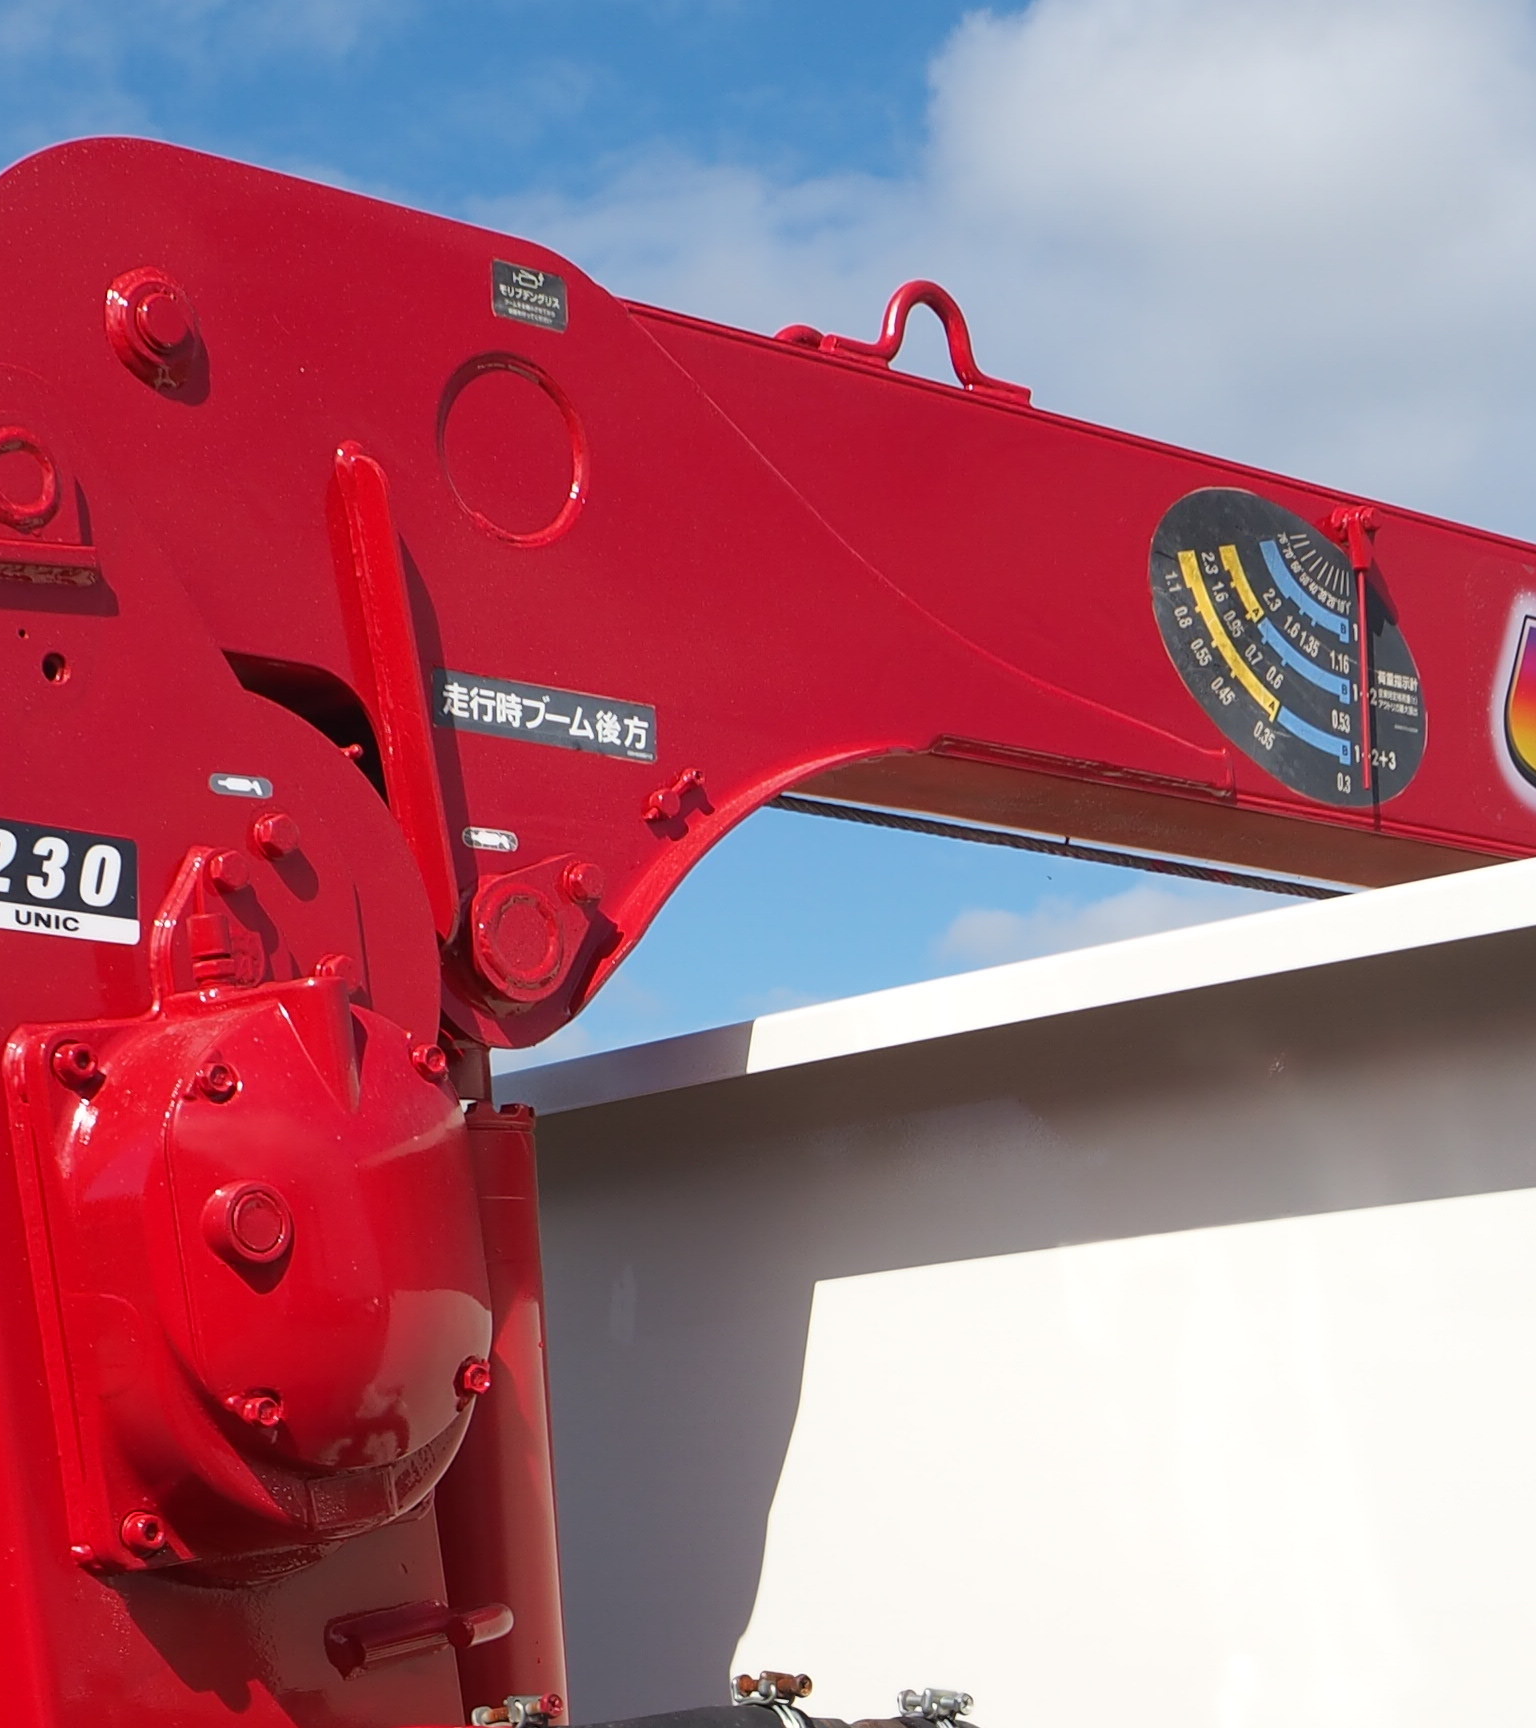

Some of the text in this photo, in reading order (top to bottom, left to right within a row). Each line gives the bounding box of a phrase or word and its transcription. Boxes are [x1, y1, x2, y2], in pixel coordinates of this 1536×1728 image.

[1201, 552, 1218, 575] 2.3
[1164, 571, 1182, 592] 1.1
[1211, 582, 1229, 604] 1.6
[1262, 589, 1282, 612] 2.3
[1173, 606, 1193, 629] 0.8
[1223, 610, 1244, 638] 0.95
[1252, 608, 1260, 618] A
[1284, 615, 1300, 638] 1.6
[1353, 623, 1358, 641] 1
[1190, 638, 1212, 667] 0.55
[1245, 643, 1263, 666] 0.7
[1299, 631, 1319, 658] 1.35
[1329, 650, 1349, 675] 1.16
[1266, 667, 1284, 689] 0.6
[1210, 677, 1236, 706] 0.45
[442, 682, 649, 750] 走行時ブーム後方
[1331, 710, 1350, 732] 0.53
[1253, 721, 1275, 751] 0.35
[1337, 772, 1351, 794] 0.3
[15, 909, 80, 932] UNIC
